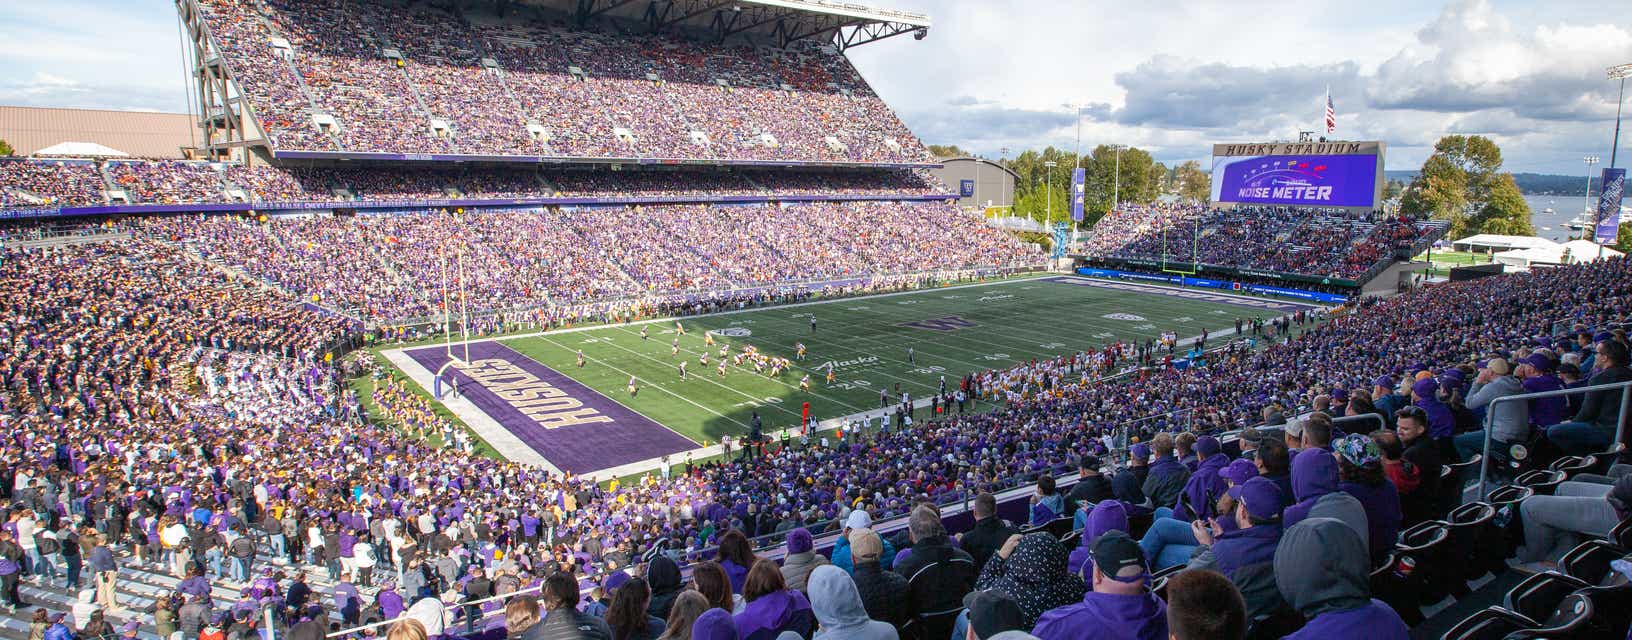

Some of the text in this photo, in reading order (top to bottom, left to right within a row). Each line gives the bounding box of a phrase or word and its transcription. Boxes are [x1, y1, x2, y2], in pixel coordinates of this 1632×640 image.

[1226, 143, 1361, 156] HUSKY STADIUM
[1238, 185, 1333, 200] NOISE METER
[811, 356, 878, 370] Alaska
[452, 359, 615, 429] HUSKIES
